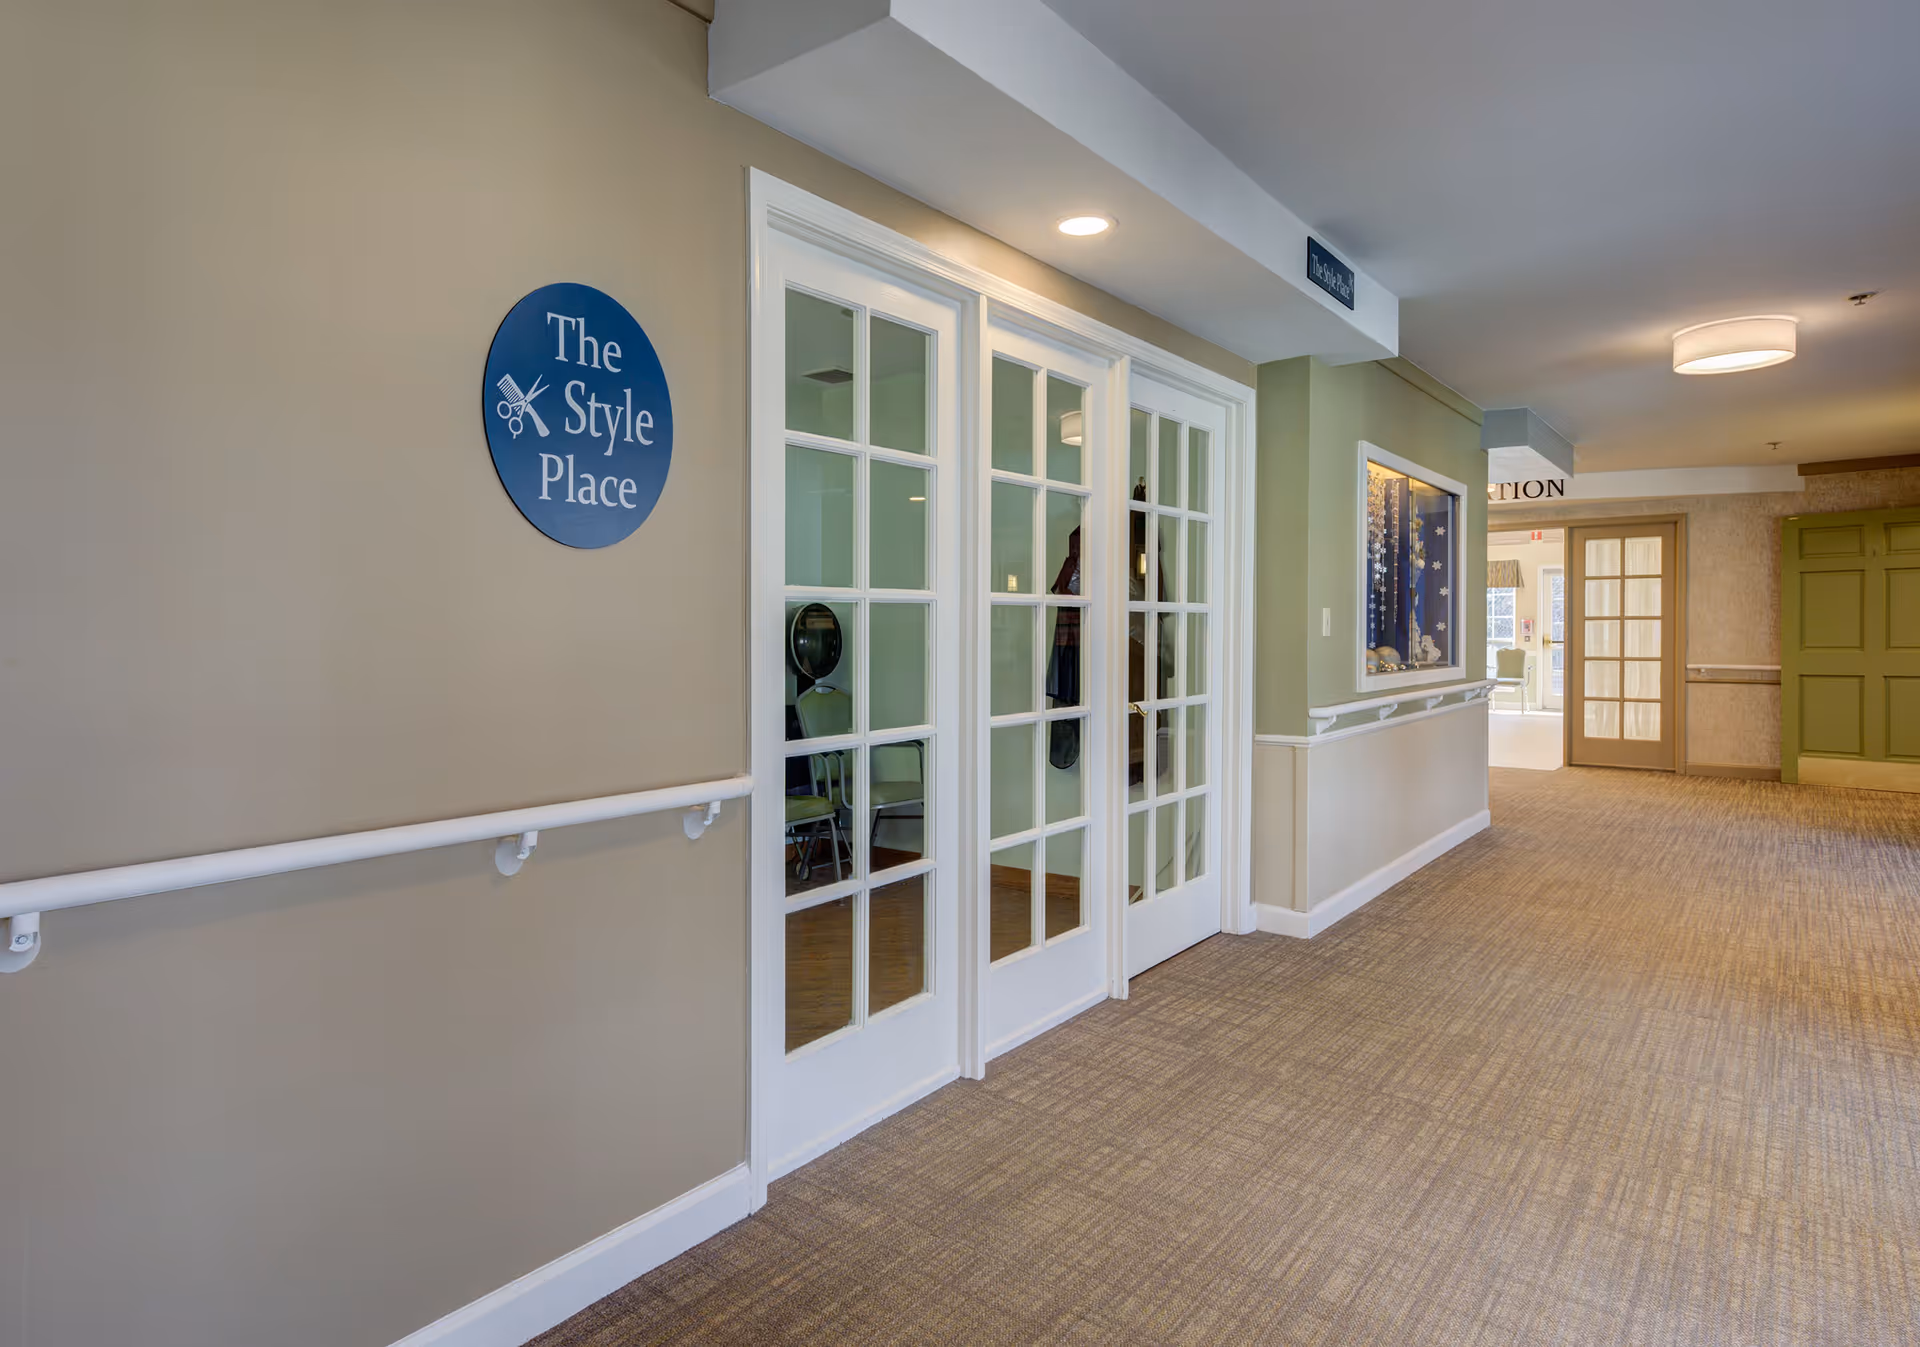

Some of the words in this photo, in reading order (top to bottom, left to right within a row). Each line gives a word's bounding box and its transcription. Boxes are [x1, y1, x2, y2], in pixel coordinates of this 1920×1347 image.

[547, 312, 621, 373] The
[564, 380, 654, 456] Style
[538, 453, 638, 509] Place
[1488, 479, 1565, 500] TION
